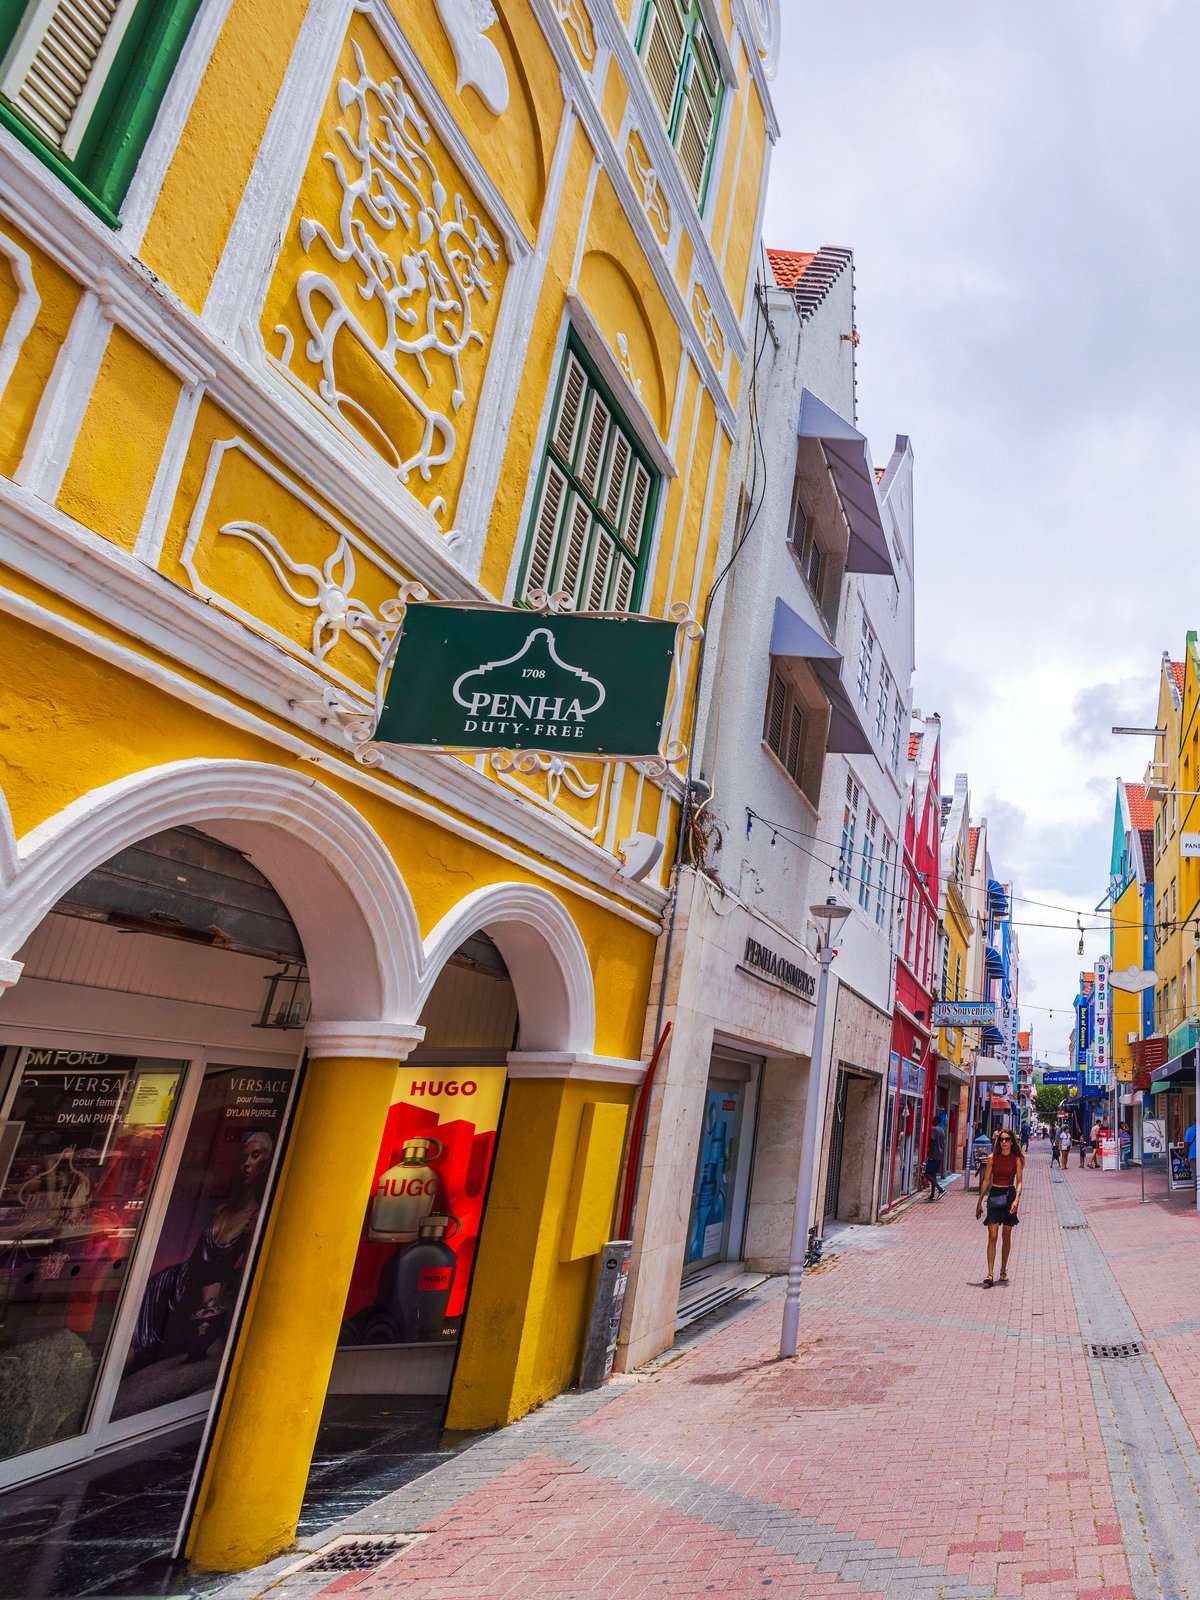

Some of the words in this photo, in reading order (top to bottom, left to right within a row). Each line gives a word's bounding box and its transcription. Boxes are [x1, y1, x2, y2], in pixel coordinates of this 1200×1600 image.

[521, 668, 546, 678] 1708
[466, 692, 586, 722] PENHA
[464, 720, 585, 738] DUTY-FREE
[744, 936, 777, 976] PENHA
[777, 957, 816, 996] COSMETICS
[952, 1003, 993, 1016] Souvenir's
[1010, 1009, 1018, 1082] ELECTRONICS
[1097, 1017, 1105, 1064] VIBES
[54, 1051, 109, 1066] FORD
[230, 1078, 288, 1093] VERSACE
[410, 1081, 477, 1096] HUGO
[72, 1098, 96, 1107] pour
[96, 1097, 126, 1107] femme
[236, 1096, 252, 1104] pour
[252, 1096, 274, 1104] femme
[57, 1113, 91, 1124] DYLAN
[93, 1113, 130, 1124] PURPLE
[226, 1108, 251, 1117] DYLAN
[251, 1109, 277, 1118] PURPLE
[375, 1178, 439, 1197] HUGO
[424, 1275, 447, 1283] HUGO
